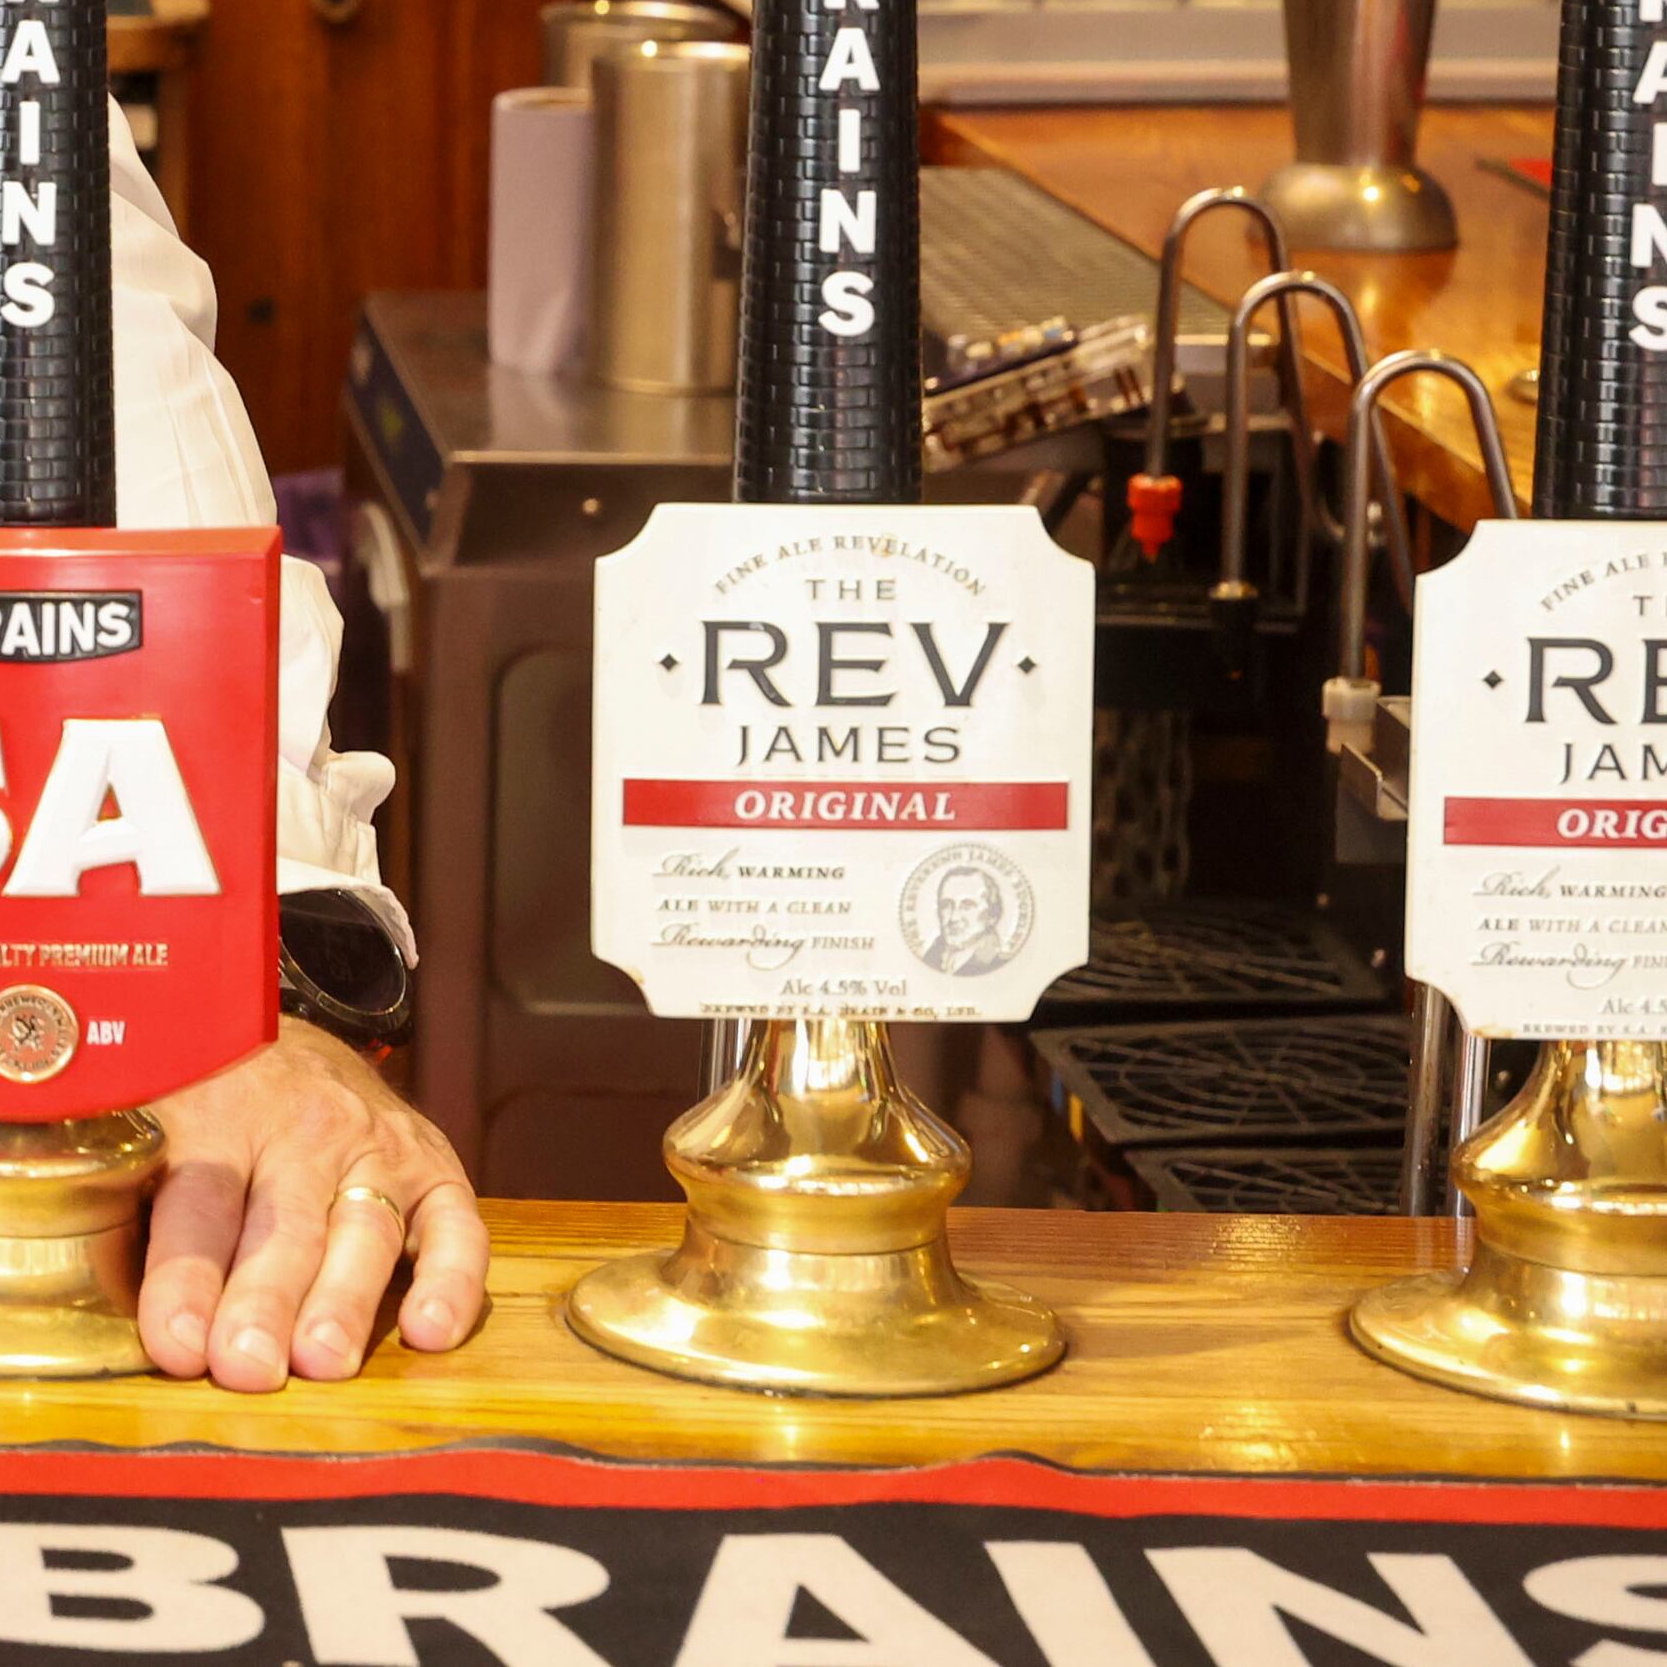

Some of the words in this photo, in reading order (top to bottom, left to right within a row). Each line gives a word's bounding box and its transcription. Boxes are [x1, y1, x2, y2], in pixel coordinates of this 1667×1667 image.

[714, 553, 769, 597] FINE
[777, 536, 823, 560] ALE
[833, 534, 987, 598] REVELATION
[805, 578, 898, 602] THE
[1539, 568, 1596, 613] FINE
[1604, 552, 1651, 578] ALE
[699, 619, 1011, 709] REV
[736, 725, 962, 767] JAMES
[1559, 742, 1667, 785] JAM
[734, 789, 956, 822] ORIGINAL
[1556, 809, 1667, 841] ORIG
[738, 865, 846, 880] WARMING
[657, 898, 699, 913] ALE
[708, 899, 759, 914] WITH
[767, 900, 779, 914] A
[785, 900, 852, 915] CLEAN
[1559, 884, 1667, 900] WARMING
[1477, 917, 1521, 933] ALE
[1527, 918, 1582, 934] WITH
[1588, 919, 1601, 934] A
[37, 942, 129, 968] PREMIUM
[131, 942, 169, 967] ALE
[651, 923, 807, 970] Rewarding
[811, 935, 875, 950] FINISH
[1469, 941, 1627, 991] Rewarding
[1631, 954, 1667, 970] FINI
[780, 979, 814, 996] Alc
[817, 980, 867, 997] 4.5%
[873, 979, 908, 997] Vol
[1601, 997, 1634, 1016] Alc
[1640, 998, 1667, 1016] 4.5
[86, 1019, 126, 1046] ABV
